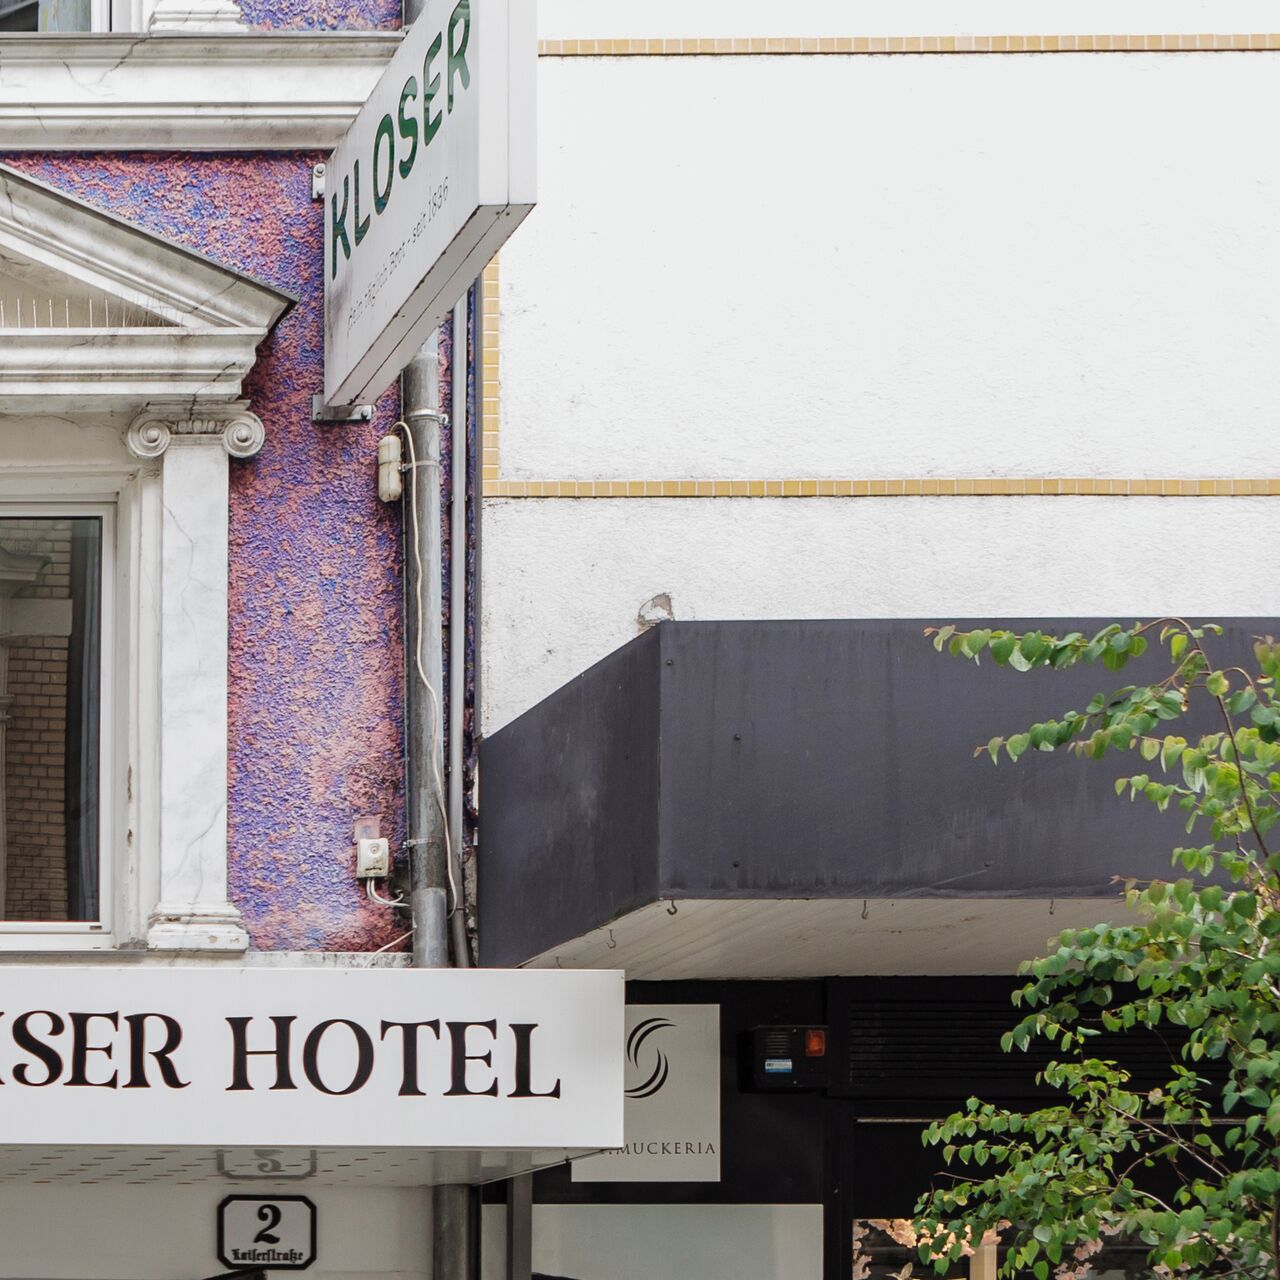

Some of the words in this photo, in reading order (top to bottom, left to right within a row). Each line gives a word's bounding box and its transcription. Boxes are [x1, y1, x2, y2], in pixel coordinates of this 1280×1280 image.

[331, 0, 470, 281] KLOSER
[389, 241, 407, 276] Brot
[412, 212, 427, 244] seit
[428, 176, 449, 223] 1836
[225, 1014, 562, 1100] HOTEL
[231, 1248, 304, 1264] Kaiserstraße
[253, 1203, 282, 1245] 2
